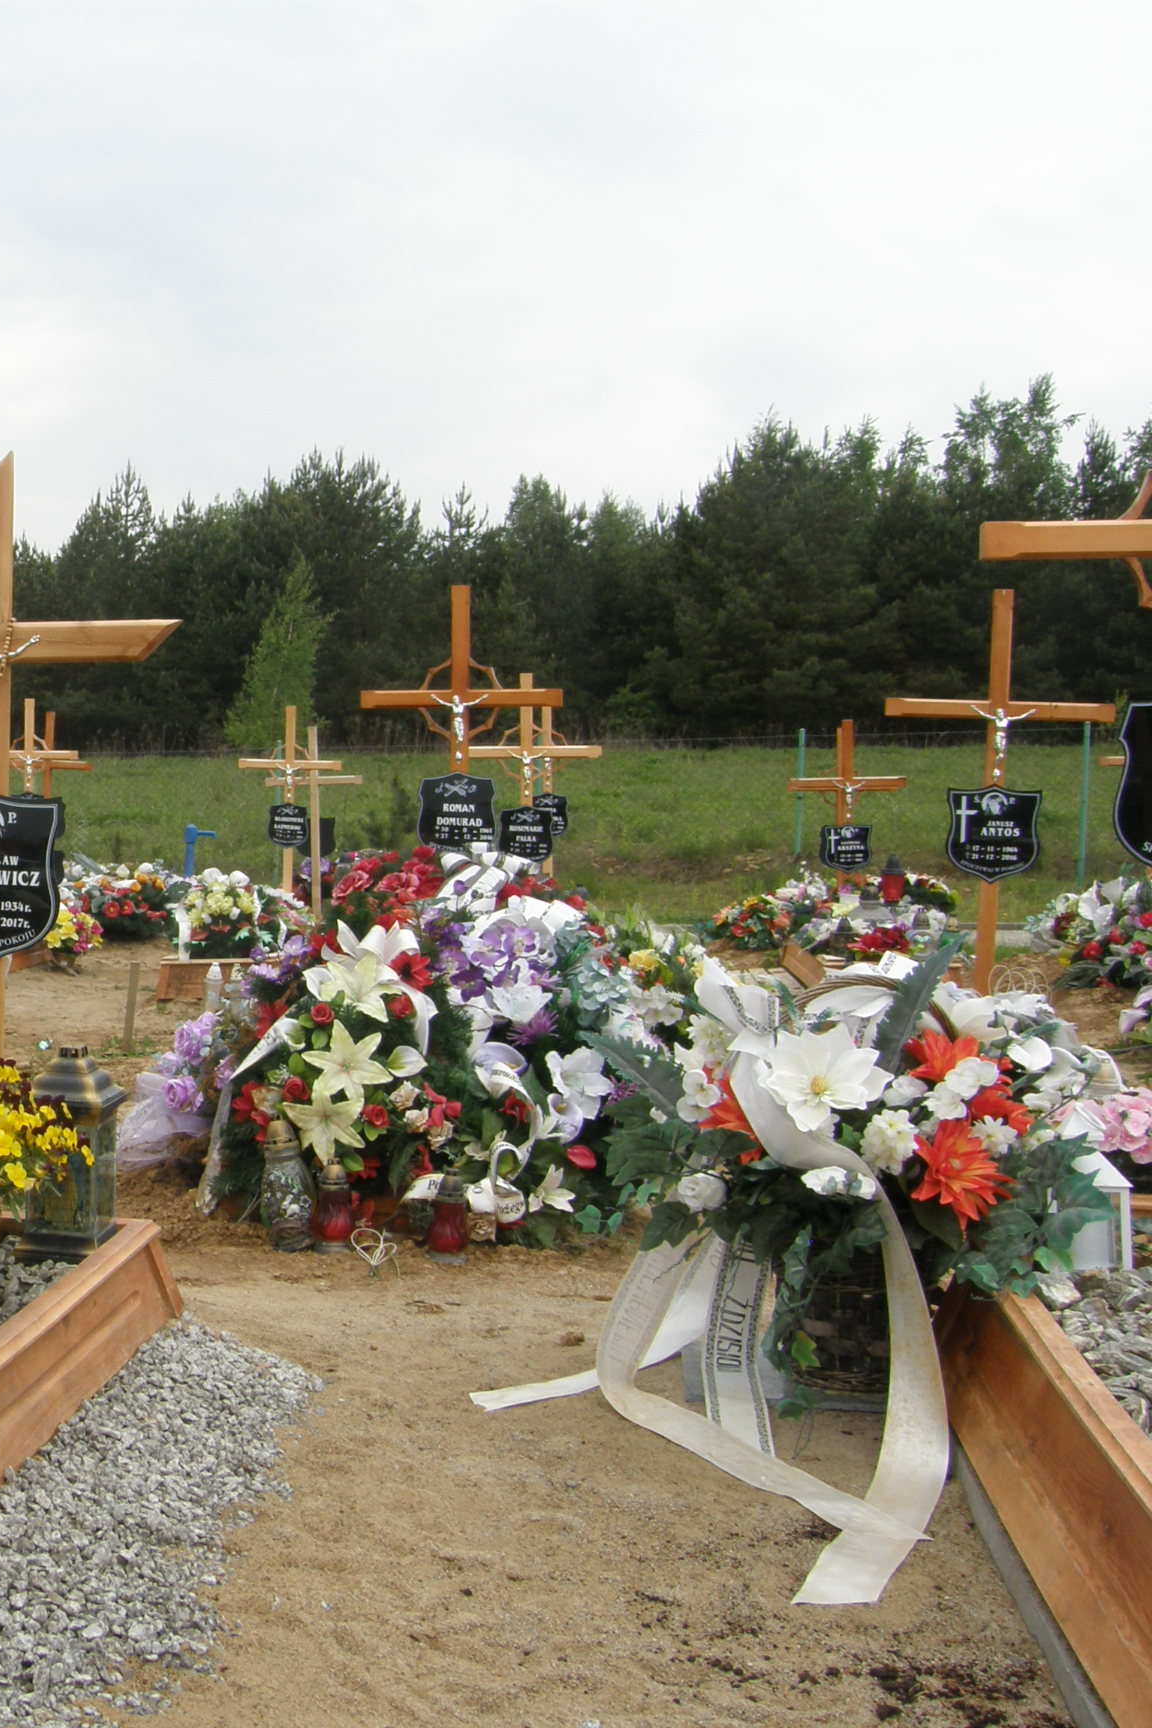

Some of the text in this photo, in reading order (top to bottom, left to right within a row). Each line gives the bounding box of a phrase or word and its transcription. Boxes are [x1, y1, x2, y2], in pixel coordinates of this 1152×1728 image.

[443, 803, 475, 812] ROMAN
[436, 816, 483, 827] DOMURAD
[980, 827, 1021, 837] ANTOS
